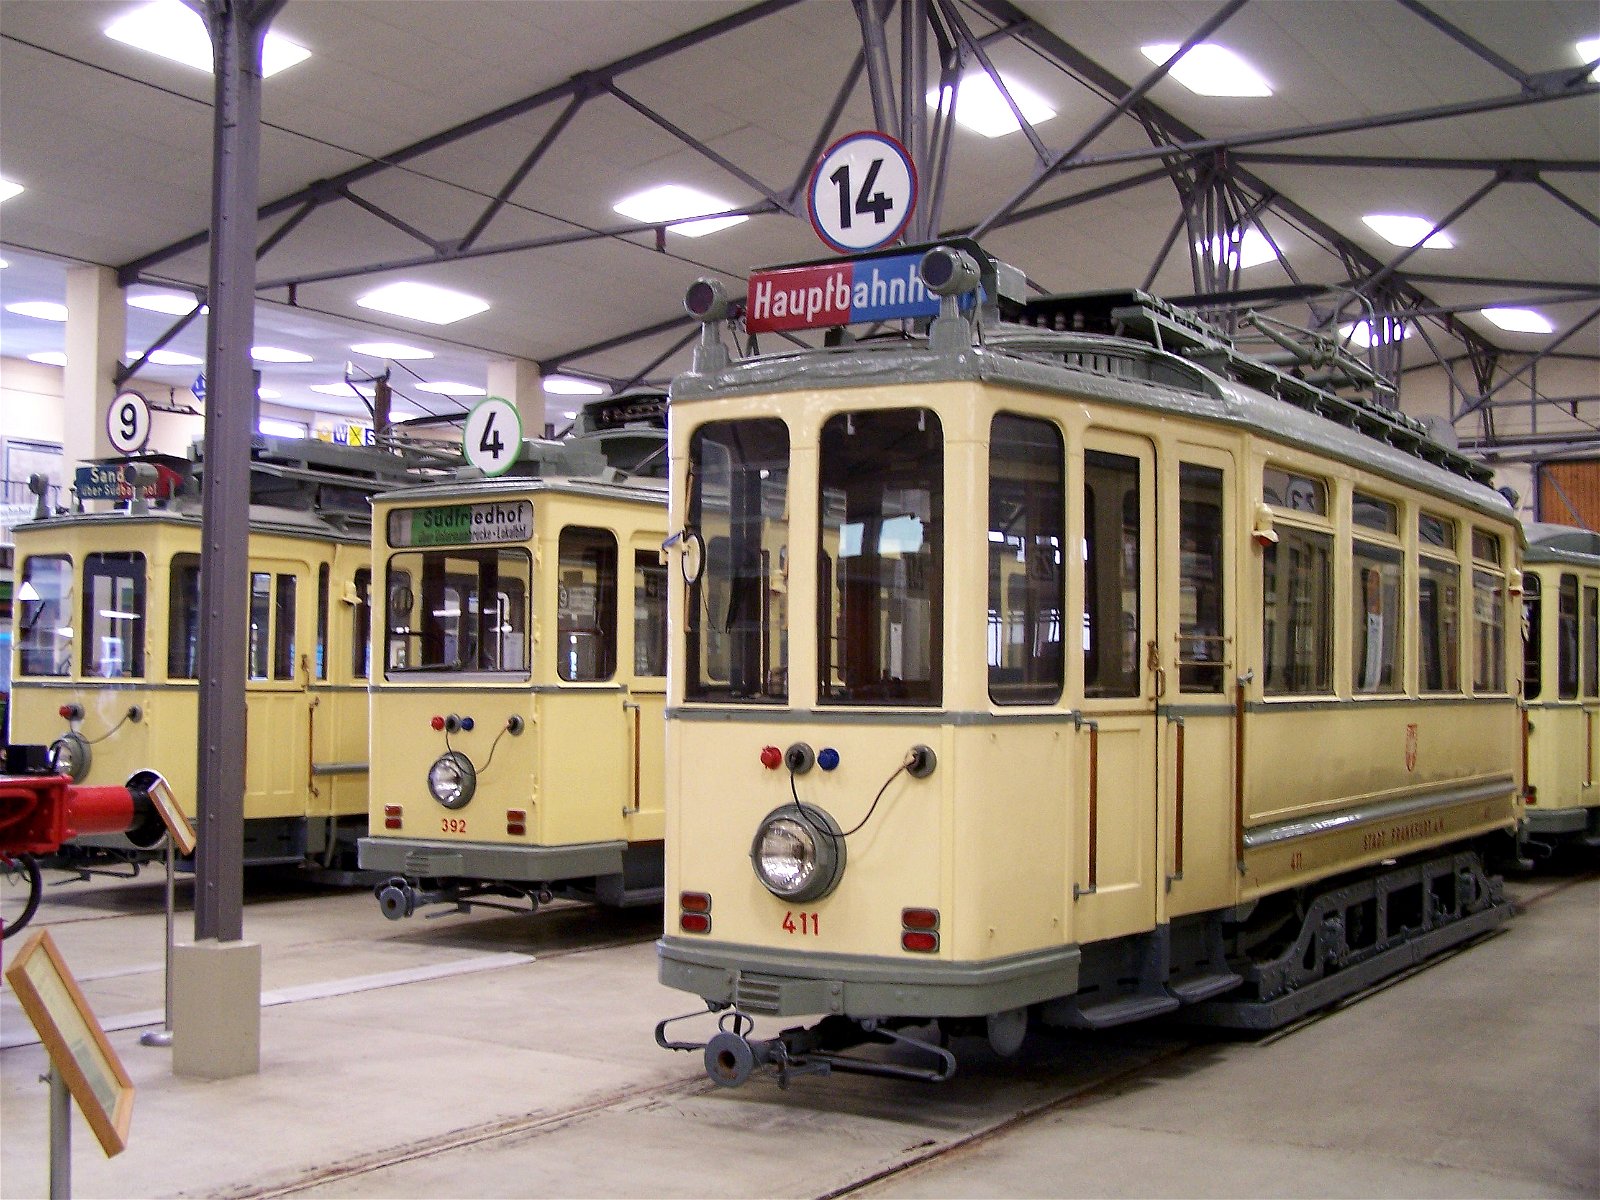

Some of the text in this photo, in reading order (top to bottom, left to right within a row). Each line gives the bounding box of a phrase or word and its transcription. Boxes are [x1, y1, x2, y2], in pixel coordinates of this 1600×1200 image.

[829, 159, 893, 230] 14
[753, 264, 941, 323] Hauptbahnh
[120, 403, 137, 441] 9
[479, 412, 504, 459] 4
[91, 467, 126, 484] Sand
[423, 503, 524, 529] Südfriedhof
[441, 818, 467, 834] 392
[782, 910, 819, 937] 411
